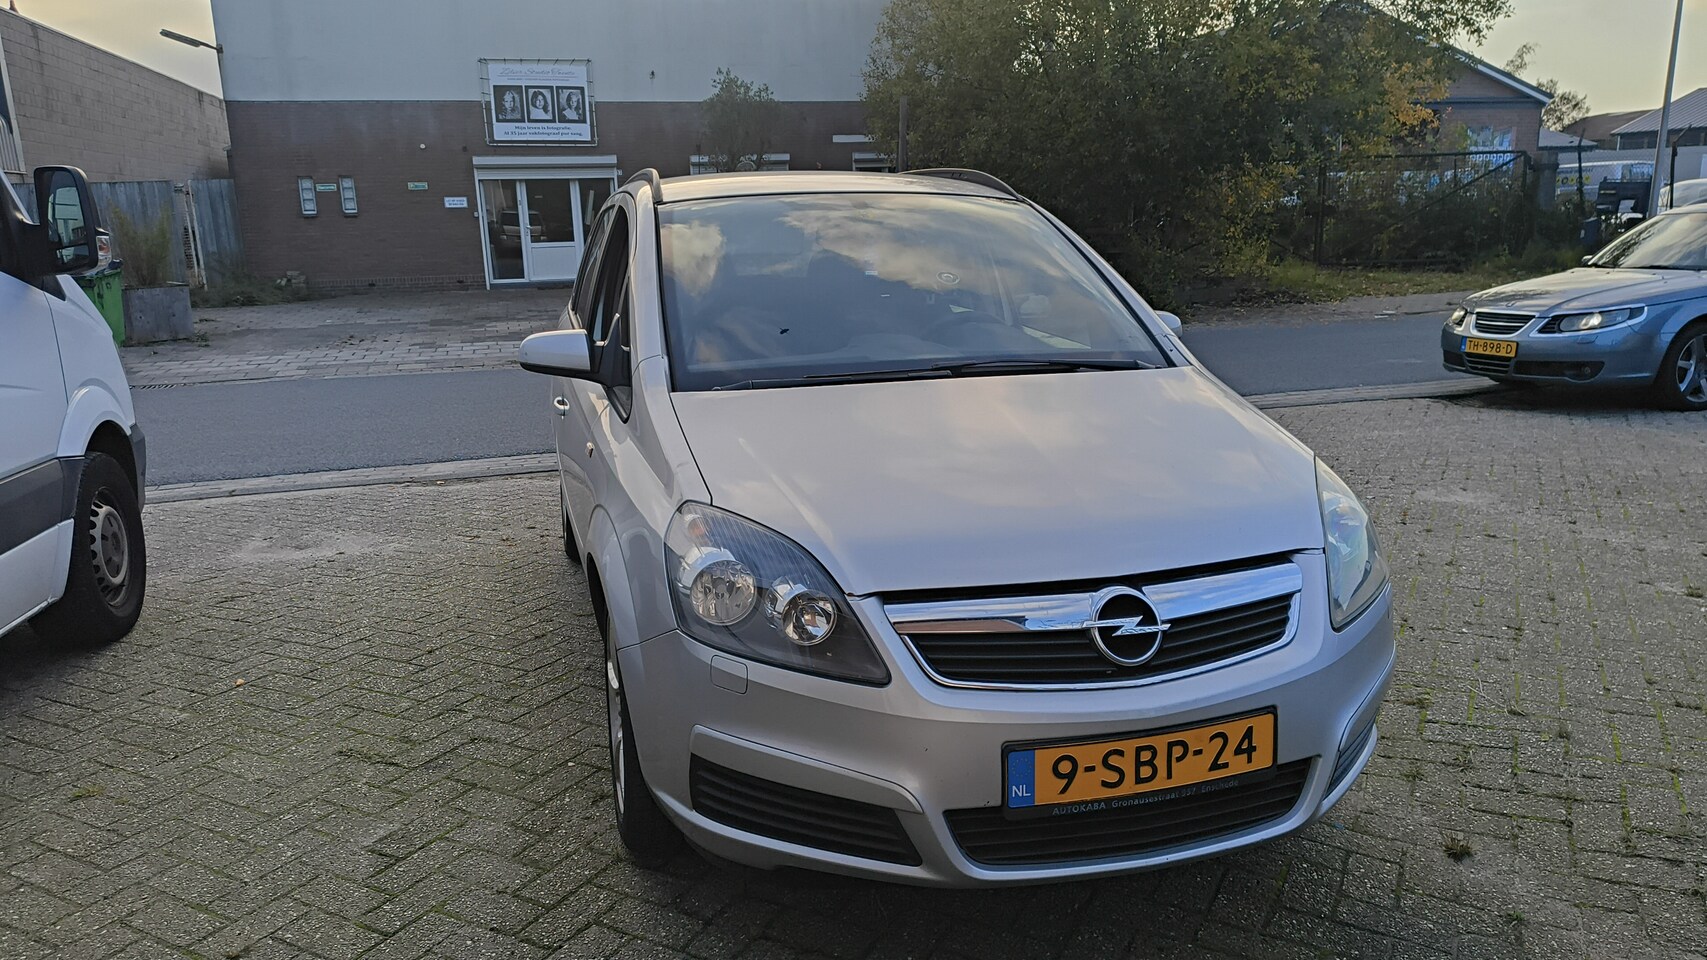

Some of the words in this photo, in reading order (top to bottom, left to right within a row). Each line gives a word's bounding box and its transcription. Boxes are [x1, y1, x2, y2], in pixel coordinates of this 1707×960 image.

[1468, 340, 1513, 355] TH-898-D
[1052, 725, 1257, 795] 9-SBP-24
[1012, 784, 1031, 798] NL
[1052, 801, 1106, 816] AUTOKABA
[1111, 790, 1180, 808] Gronausestraat
[1201, 779, 1239, 793] Enschede
